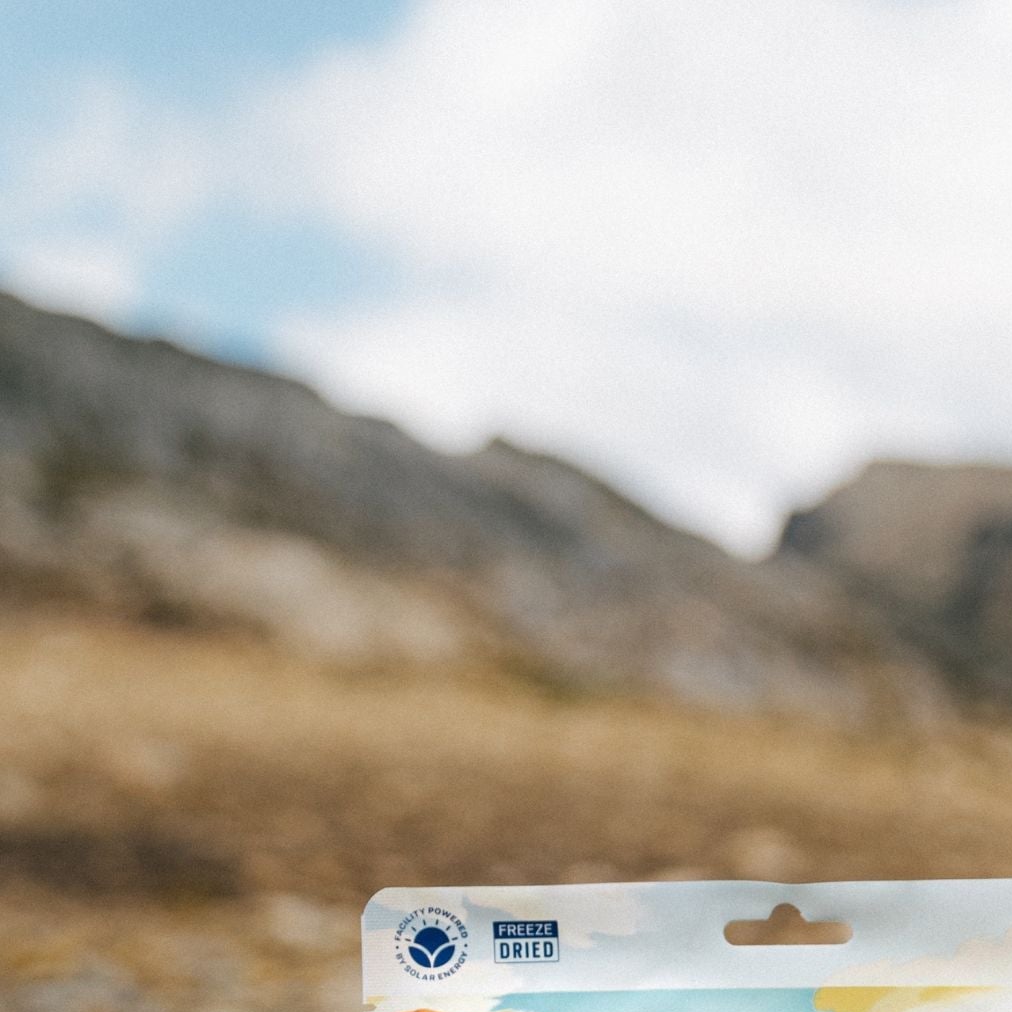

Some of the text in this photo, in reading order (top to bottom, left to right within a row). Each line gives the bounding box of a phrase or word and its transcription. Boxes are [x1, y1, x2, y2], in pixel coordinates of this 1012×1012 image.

[394, 906, 469, 942] FACILITY POWERED
[498, 923, 553, 937] FREEZE
[499, 941, 554, 959] DRIED
[395, 951, 468, 981] BY SOLAR ENERGY
